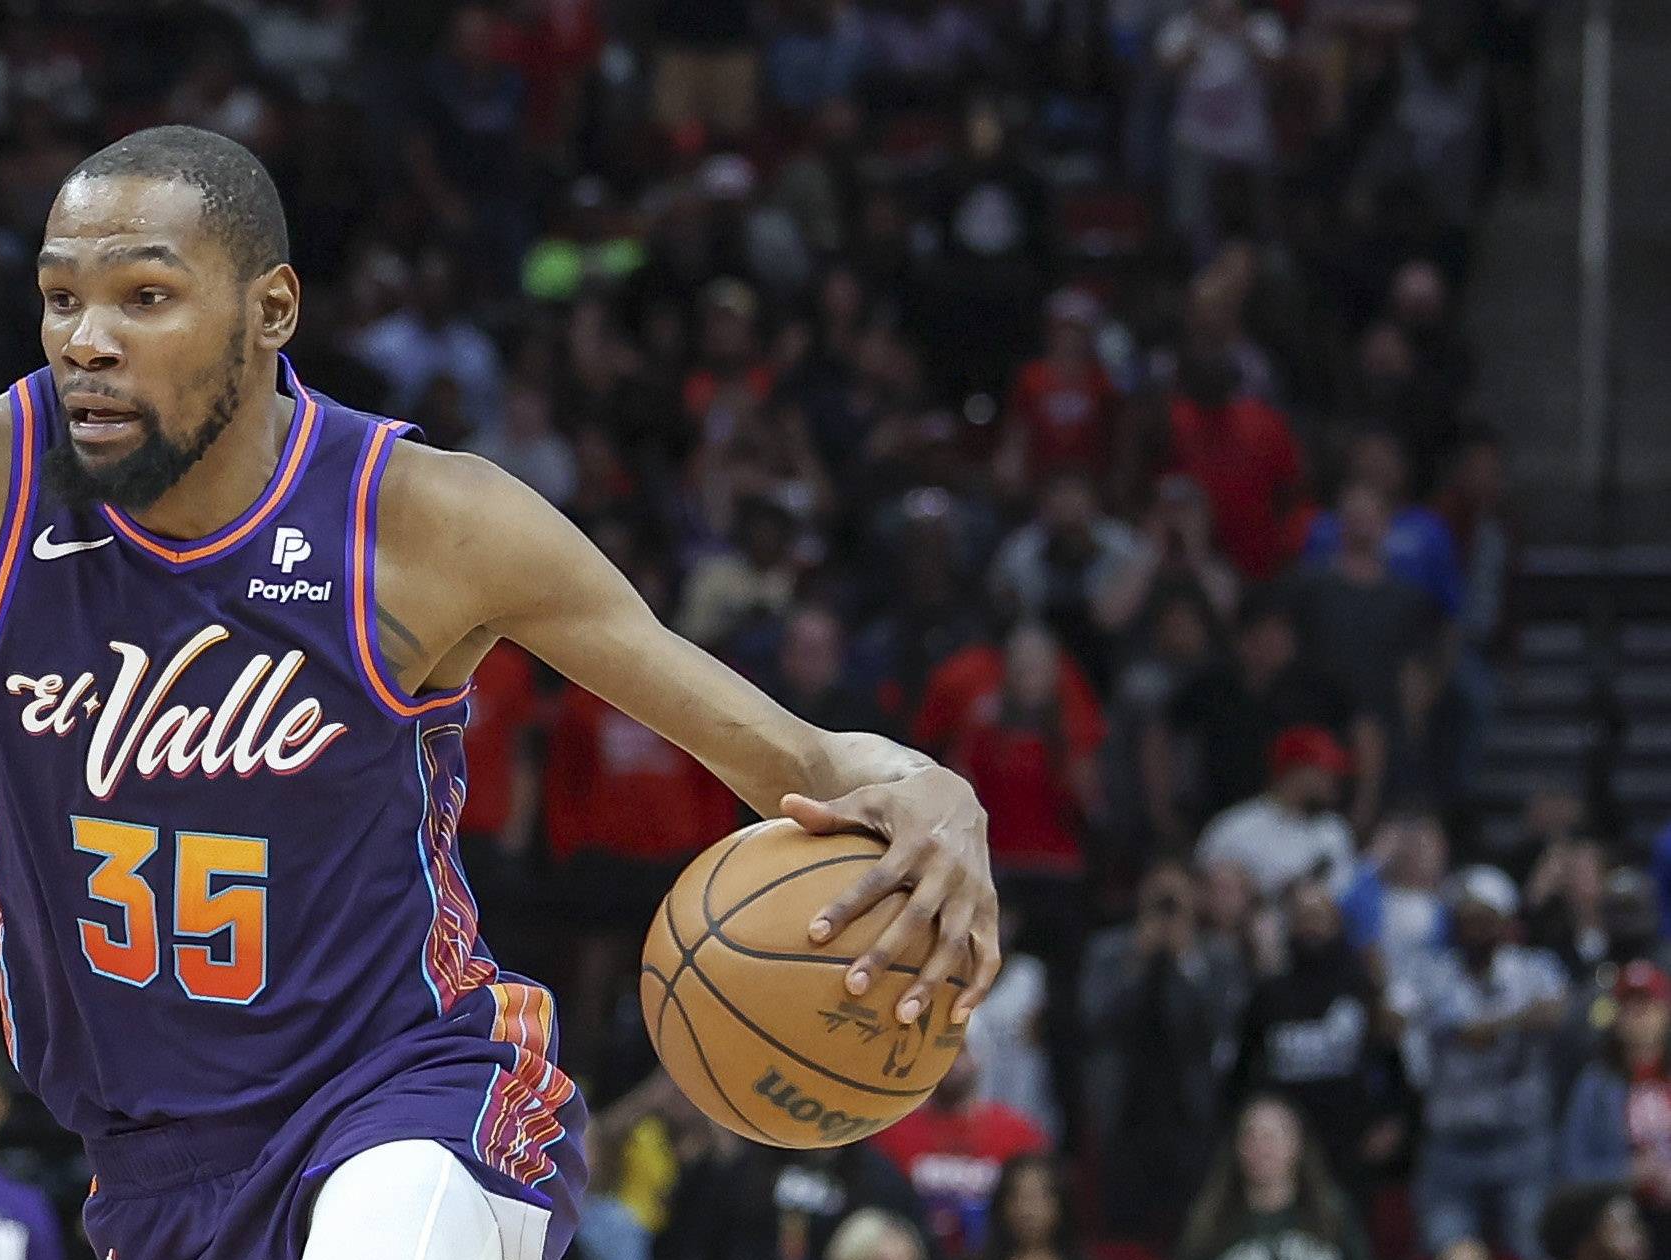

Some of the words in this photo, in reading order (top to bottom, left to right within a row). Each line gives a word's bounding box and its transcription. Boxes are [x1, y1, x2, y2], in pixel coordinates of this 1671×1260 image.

[247, 578, 332, 603] PayPal
[5, 671, 95, 735] El
[86, 624, 347, 800] Valle
[69, 814, 269, 1006] 35
